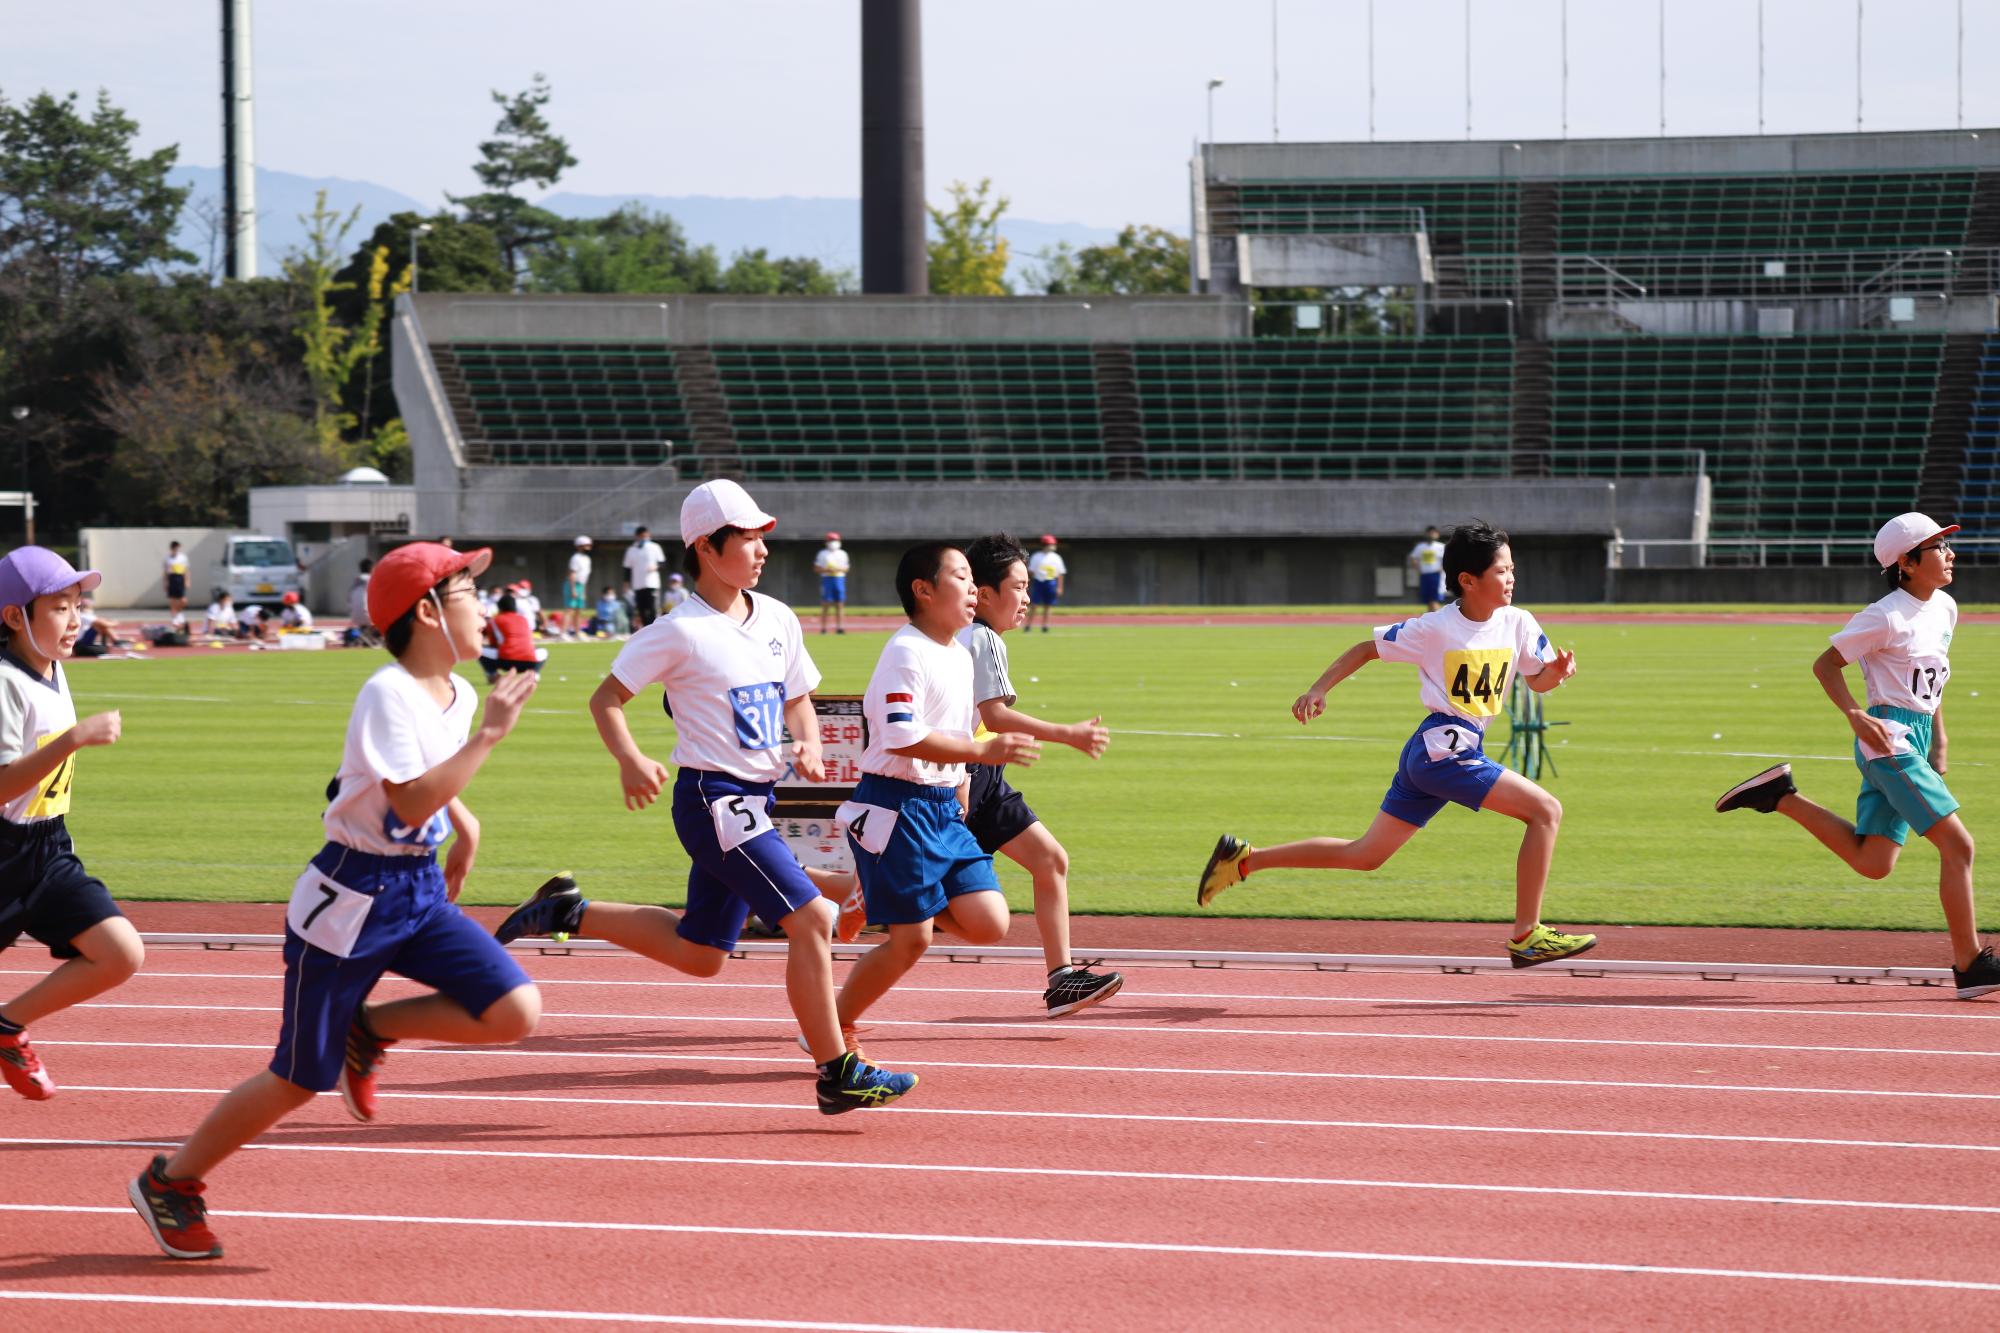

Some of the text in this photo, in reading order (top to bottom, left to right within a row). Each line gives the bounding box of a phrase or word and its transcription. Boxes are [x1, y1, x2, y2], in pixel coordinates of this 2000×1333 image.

[1451, 661, 1509, 704] 444
[728, 796, 757, 833] 5
[849, 809, 871, 842] 4
[302, 882, 339, 931] 7
